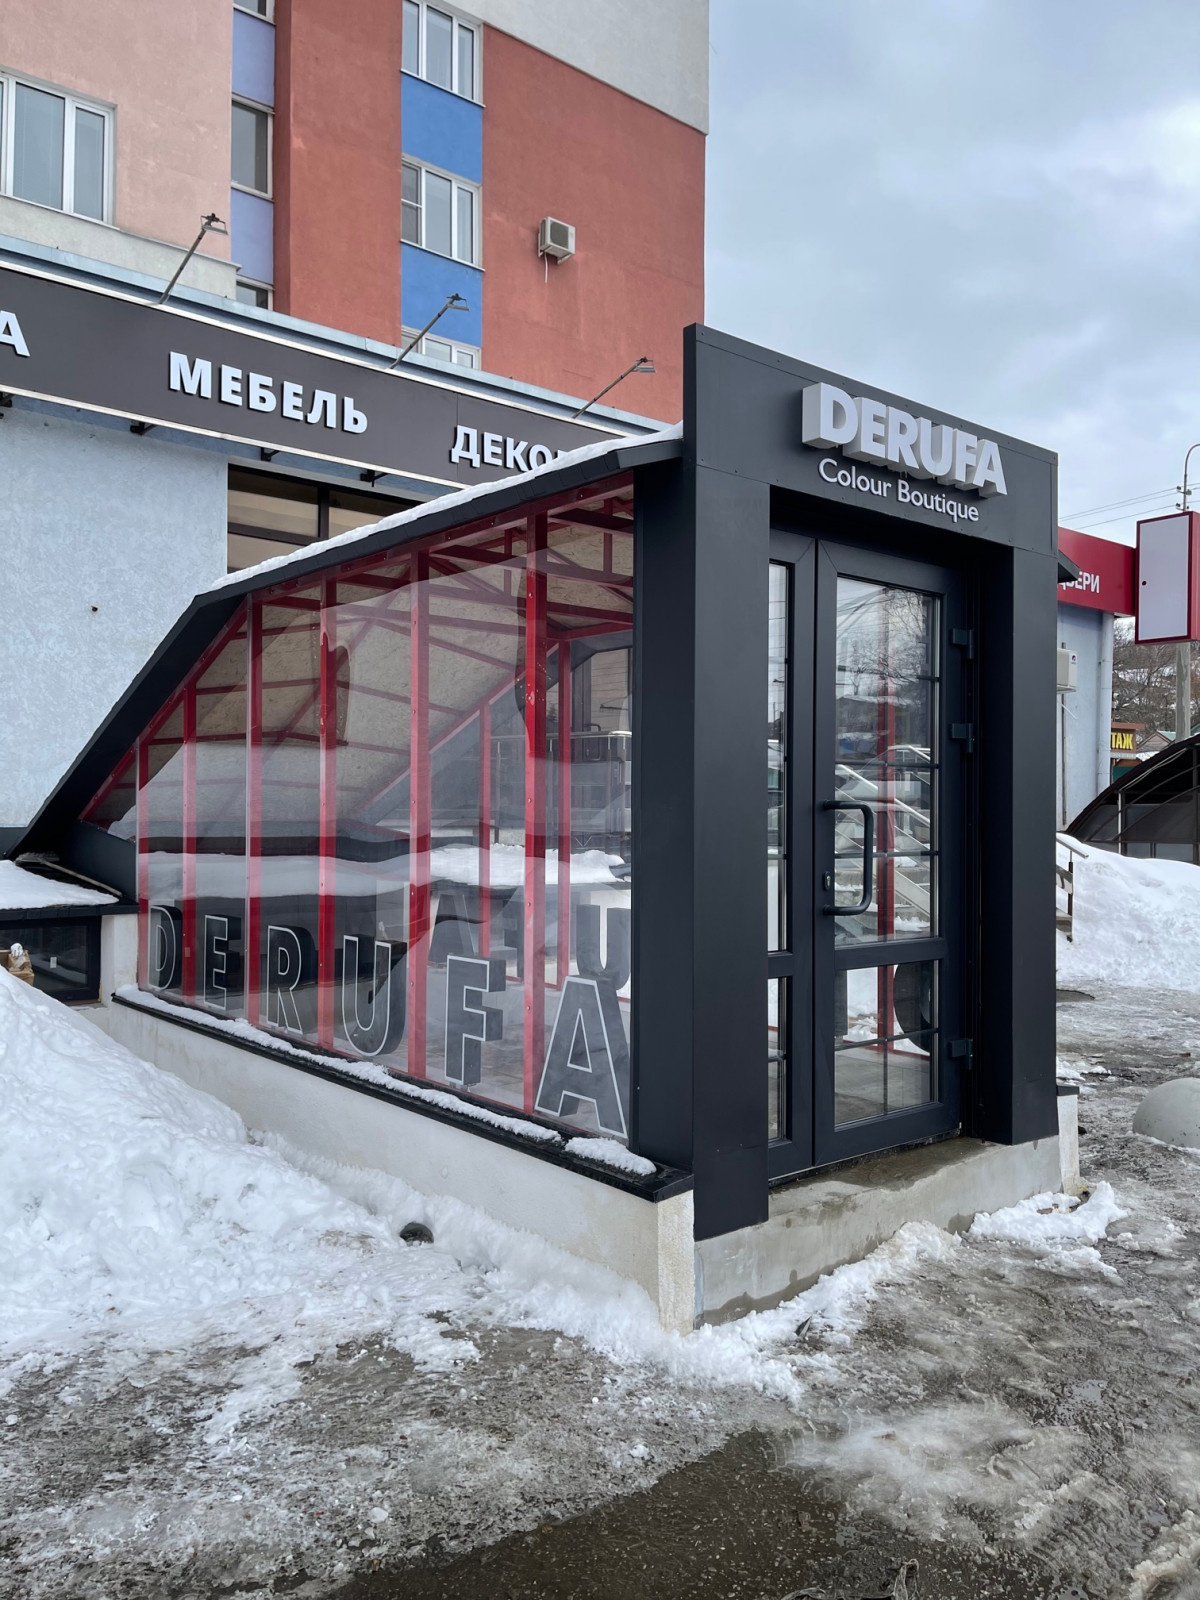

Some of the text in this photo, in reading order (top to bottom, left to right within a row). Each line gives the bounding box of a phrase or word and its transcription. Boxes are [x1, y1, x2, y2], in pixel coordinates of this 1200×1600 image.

[168, 351, 368, 434] МЕБЕЛЬ
[450, 424, 568, 473] ДЕКО
[802, 381, 1007, 499] DERUFA
[818, 458, 980, 523] Colour Boutique
